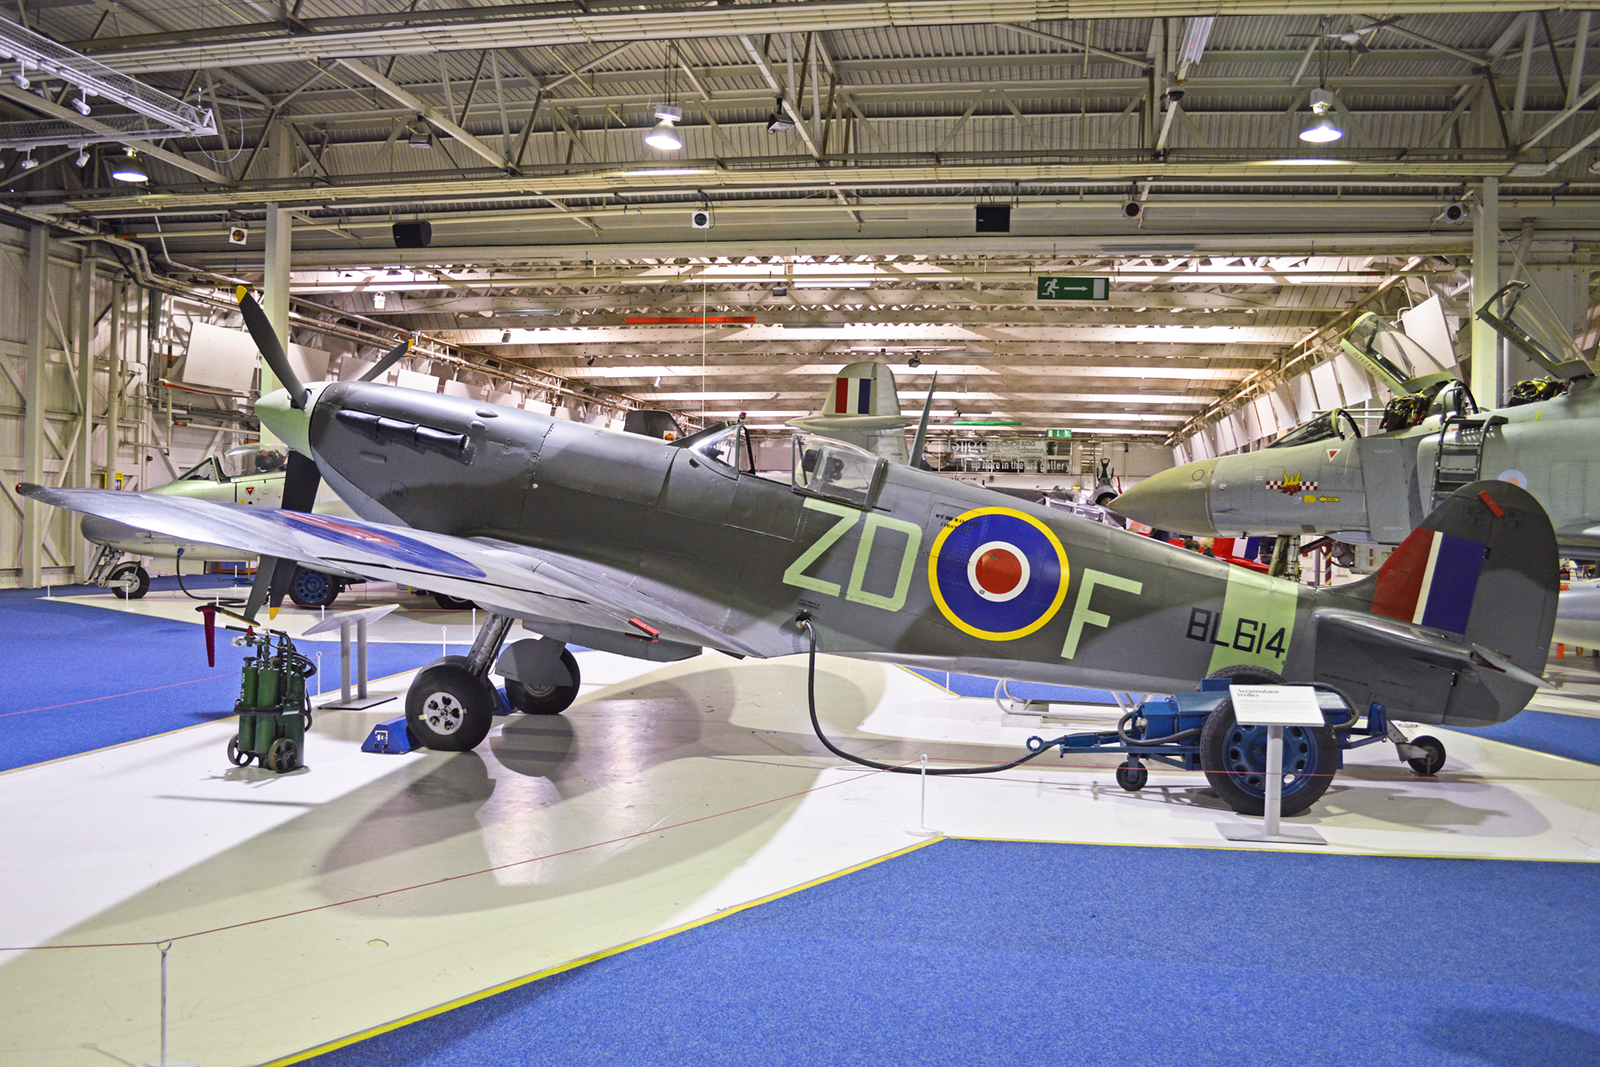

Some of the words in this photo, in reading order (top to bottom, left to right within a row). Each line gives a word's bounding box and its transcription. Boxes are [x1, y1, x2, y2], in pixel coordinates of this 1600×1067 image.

[971, 462, 980, 471] up
[982, 460, 1000, 470] here
[1001, 460, 1010, 470] in
[1011, 460, 1024, 470] the
[1025, 460, 1038, 470] art
[1040, 460, 1071, 472] gallery
[782, 497, 922, 612] ZD
[1060, 568, 1142, 659] F
[1186, 607, 1285, 658] BL614
